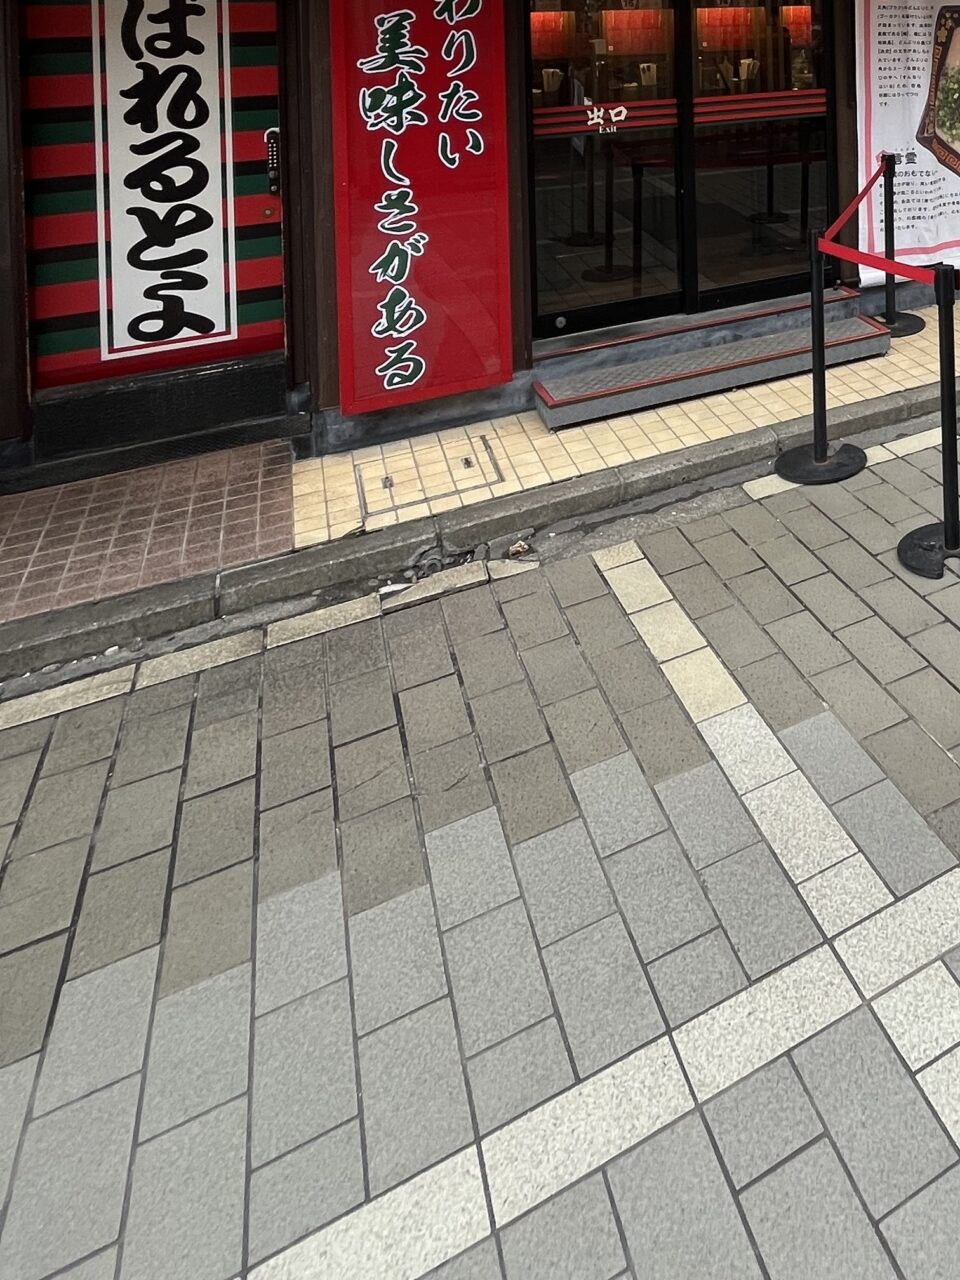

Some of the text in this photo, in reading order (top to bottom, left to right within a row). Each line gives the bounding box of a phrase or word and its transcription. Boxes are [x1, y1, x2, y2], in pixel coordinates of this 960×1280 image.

[586, 106, 628, 126] 出口
[599, 125, 617, 134] Exit
[357, 10, 430, 390] 美味しさがある
